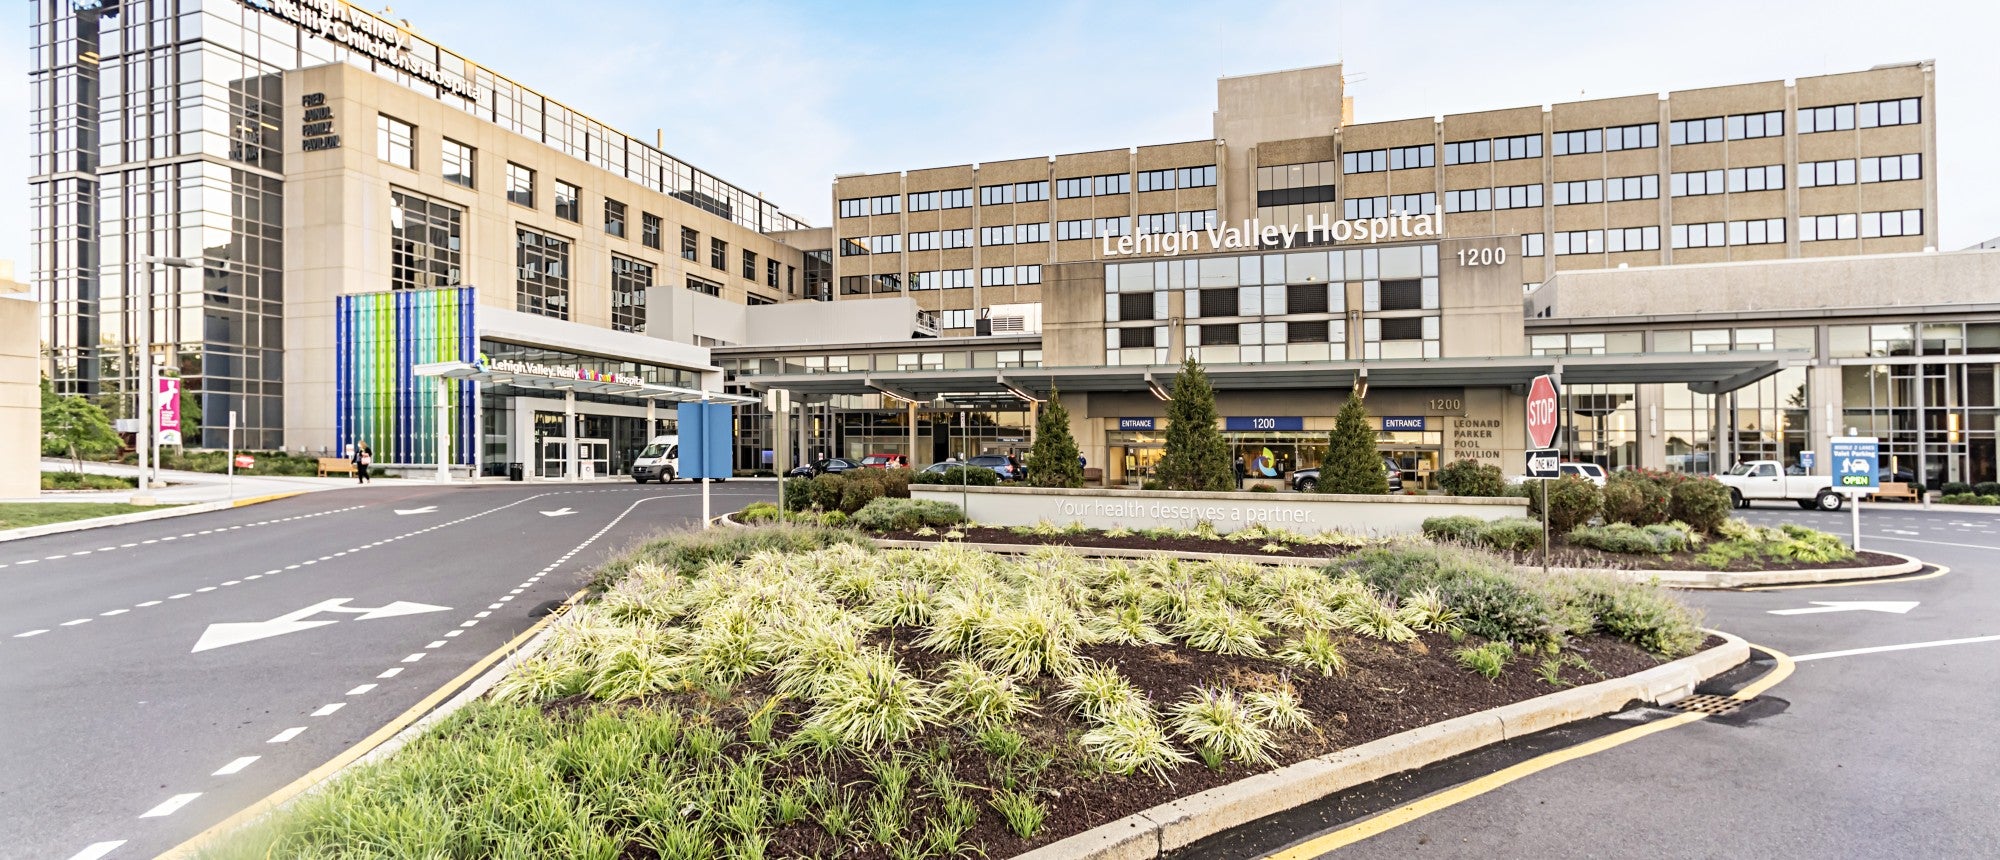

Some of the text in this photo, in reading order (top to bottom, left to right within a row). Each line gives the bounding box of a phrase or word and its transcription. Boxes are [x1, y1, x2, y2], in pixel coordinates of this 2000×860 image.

[349, 6, 404, 51] Valley
[419, 60, 482, 100] Hospital
[302, 92, 325, 107] FRED
[302, 121, 333, 137] FAMILY
[302, 135, 341, 152] PAVILION
[1103, 205, 1442, 256] Lehigh Valley Hospital
[1457, 247, 1506, 266] 1200
[491, 358, 525, 375] Lehigh
[525, 362, 554, 378] Valley
[556, 366, 579, 380] Reilly
[616, 372, 645, 387] Hospital
[1430, 399, 1460, 410] 1200
[1529, 397, 1555, 426] STOP
[1121, 419, 1151, 427] ENTRANCE
[1252, 418, 1275, 429] 1200
[1386, 419, 1422, 428] ENTRANCE
[1454, 420, 1500, 428] LEONARD
[1454, 430, 1492, 438] PARKER
[1454, 440, 1480, 448] POOL
[1454, 450, 1500, 458] PAVILION
[1536, 457, 1555, 469] ONE WAY
[1843, 476, 1869, 485] OPEN
[1055, 499, 1316, 523] Your health deserves a partner.
